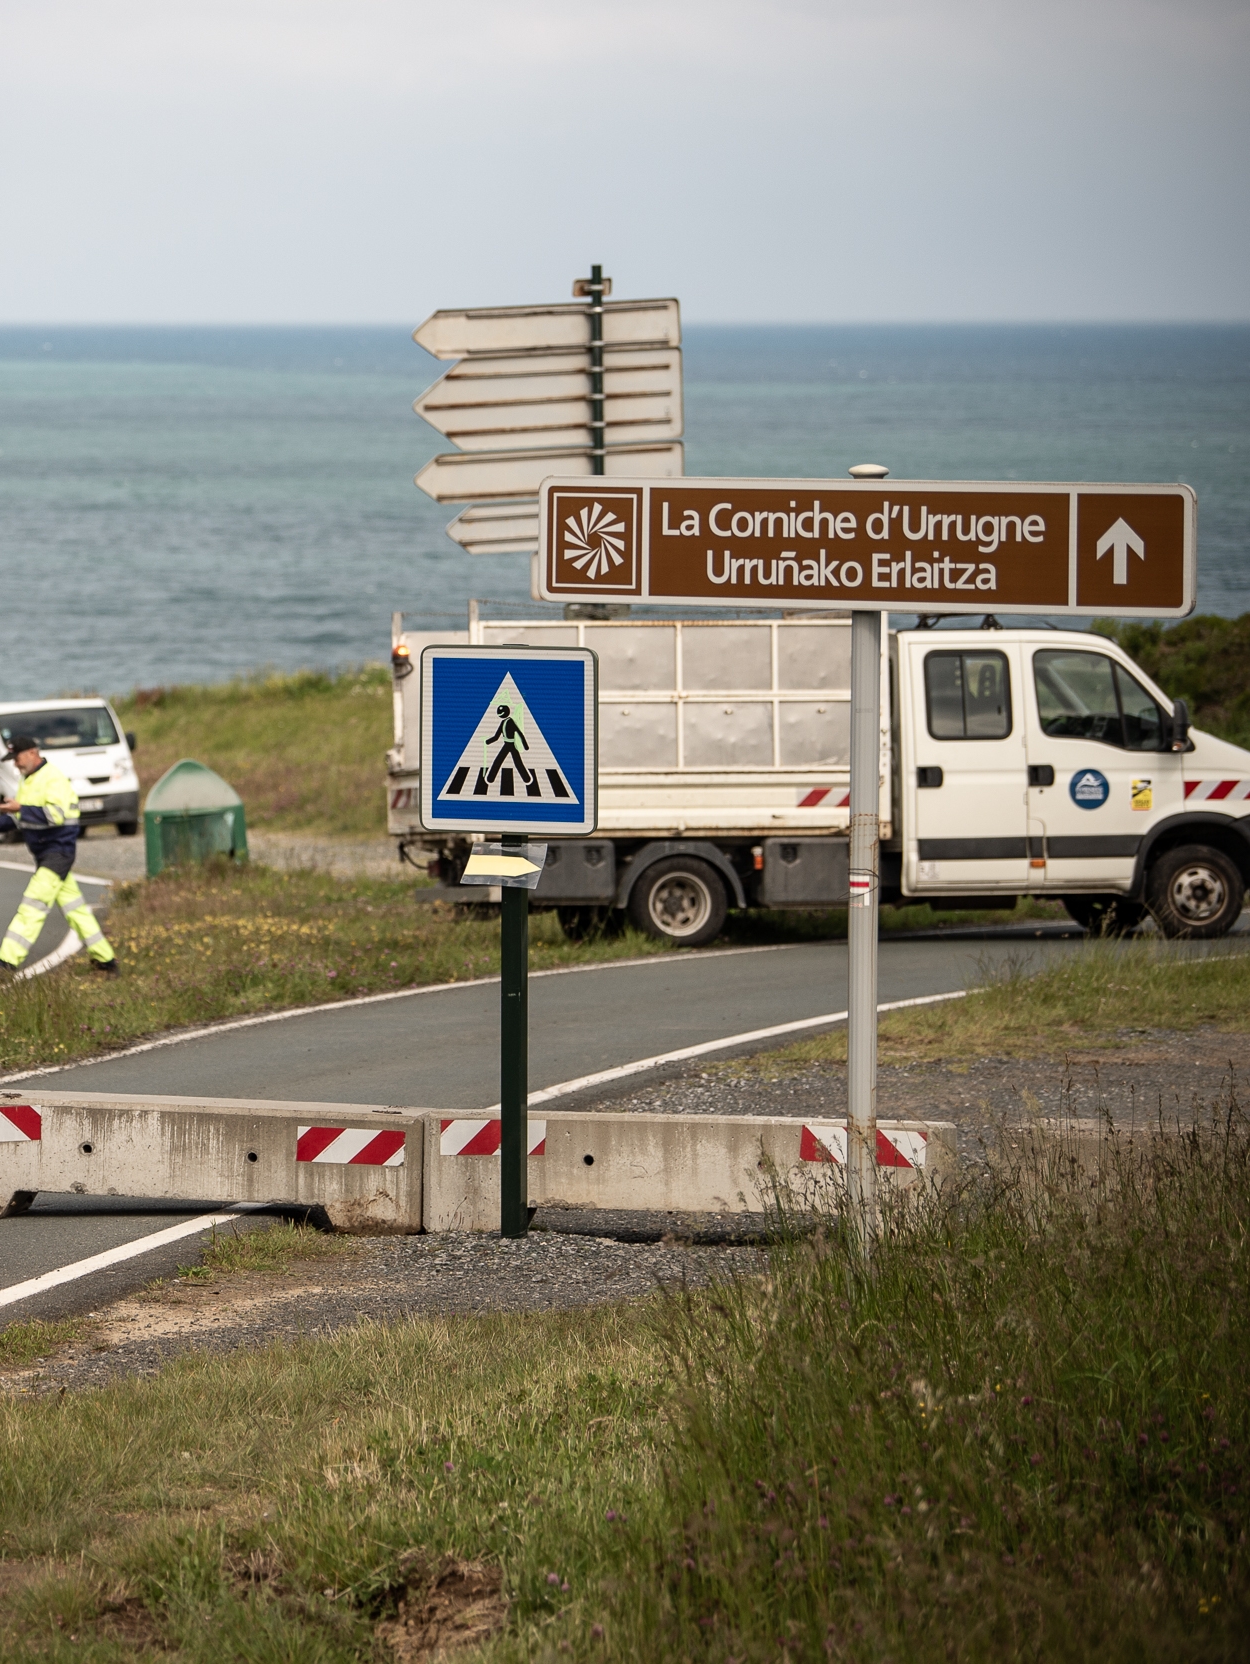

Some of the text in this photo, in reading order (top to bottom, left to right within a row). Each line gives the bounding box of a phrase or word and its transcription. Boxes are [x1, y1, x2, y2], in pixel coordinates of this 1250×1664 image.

[661, 501, 1046, 553] La Corniche d'Urrugne
[706, 548, 997, 590] Urruñako Erlaitza
